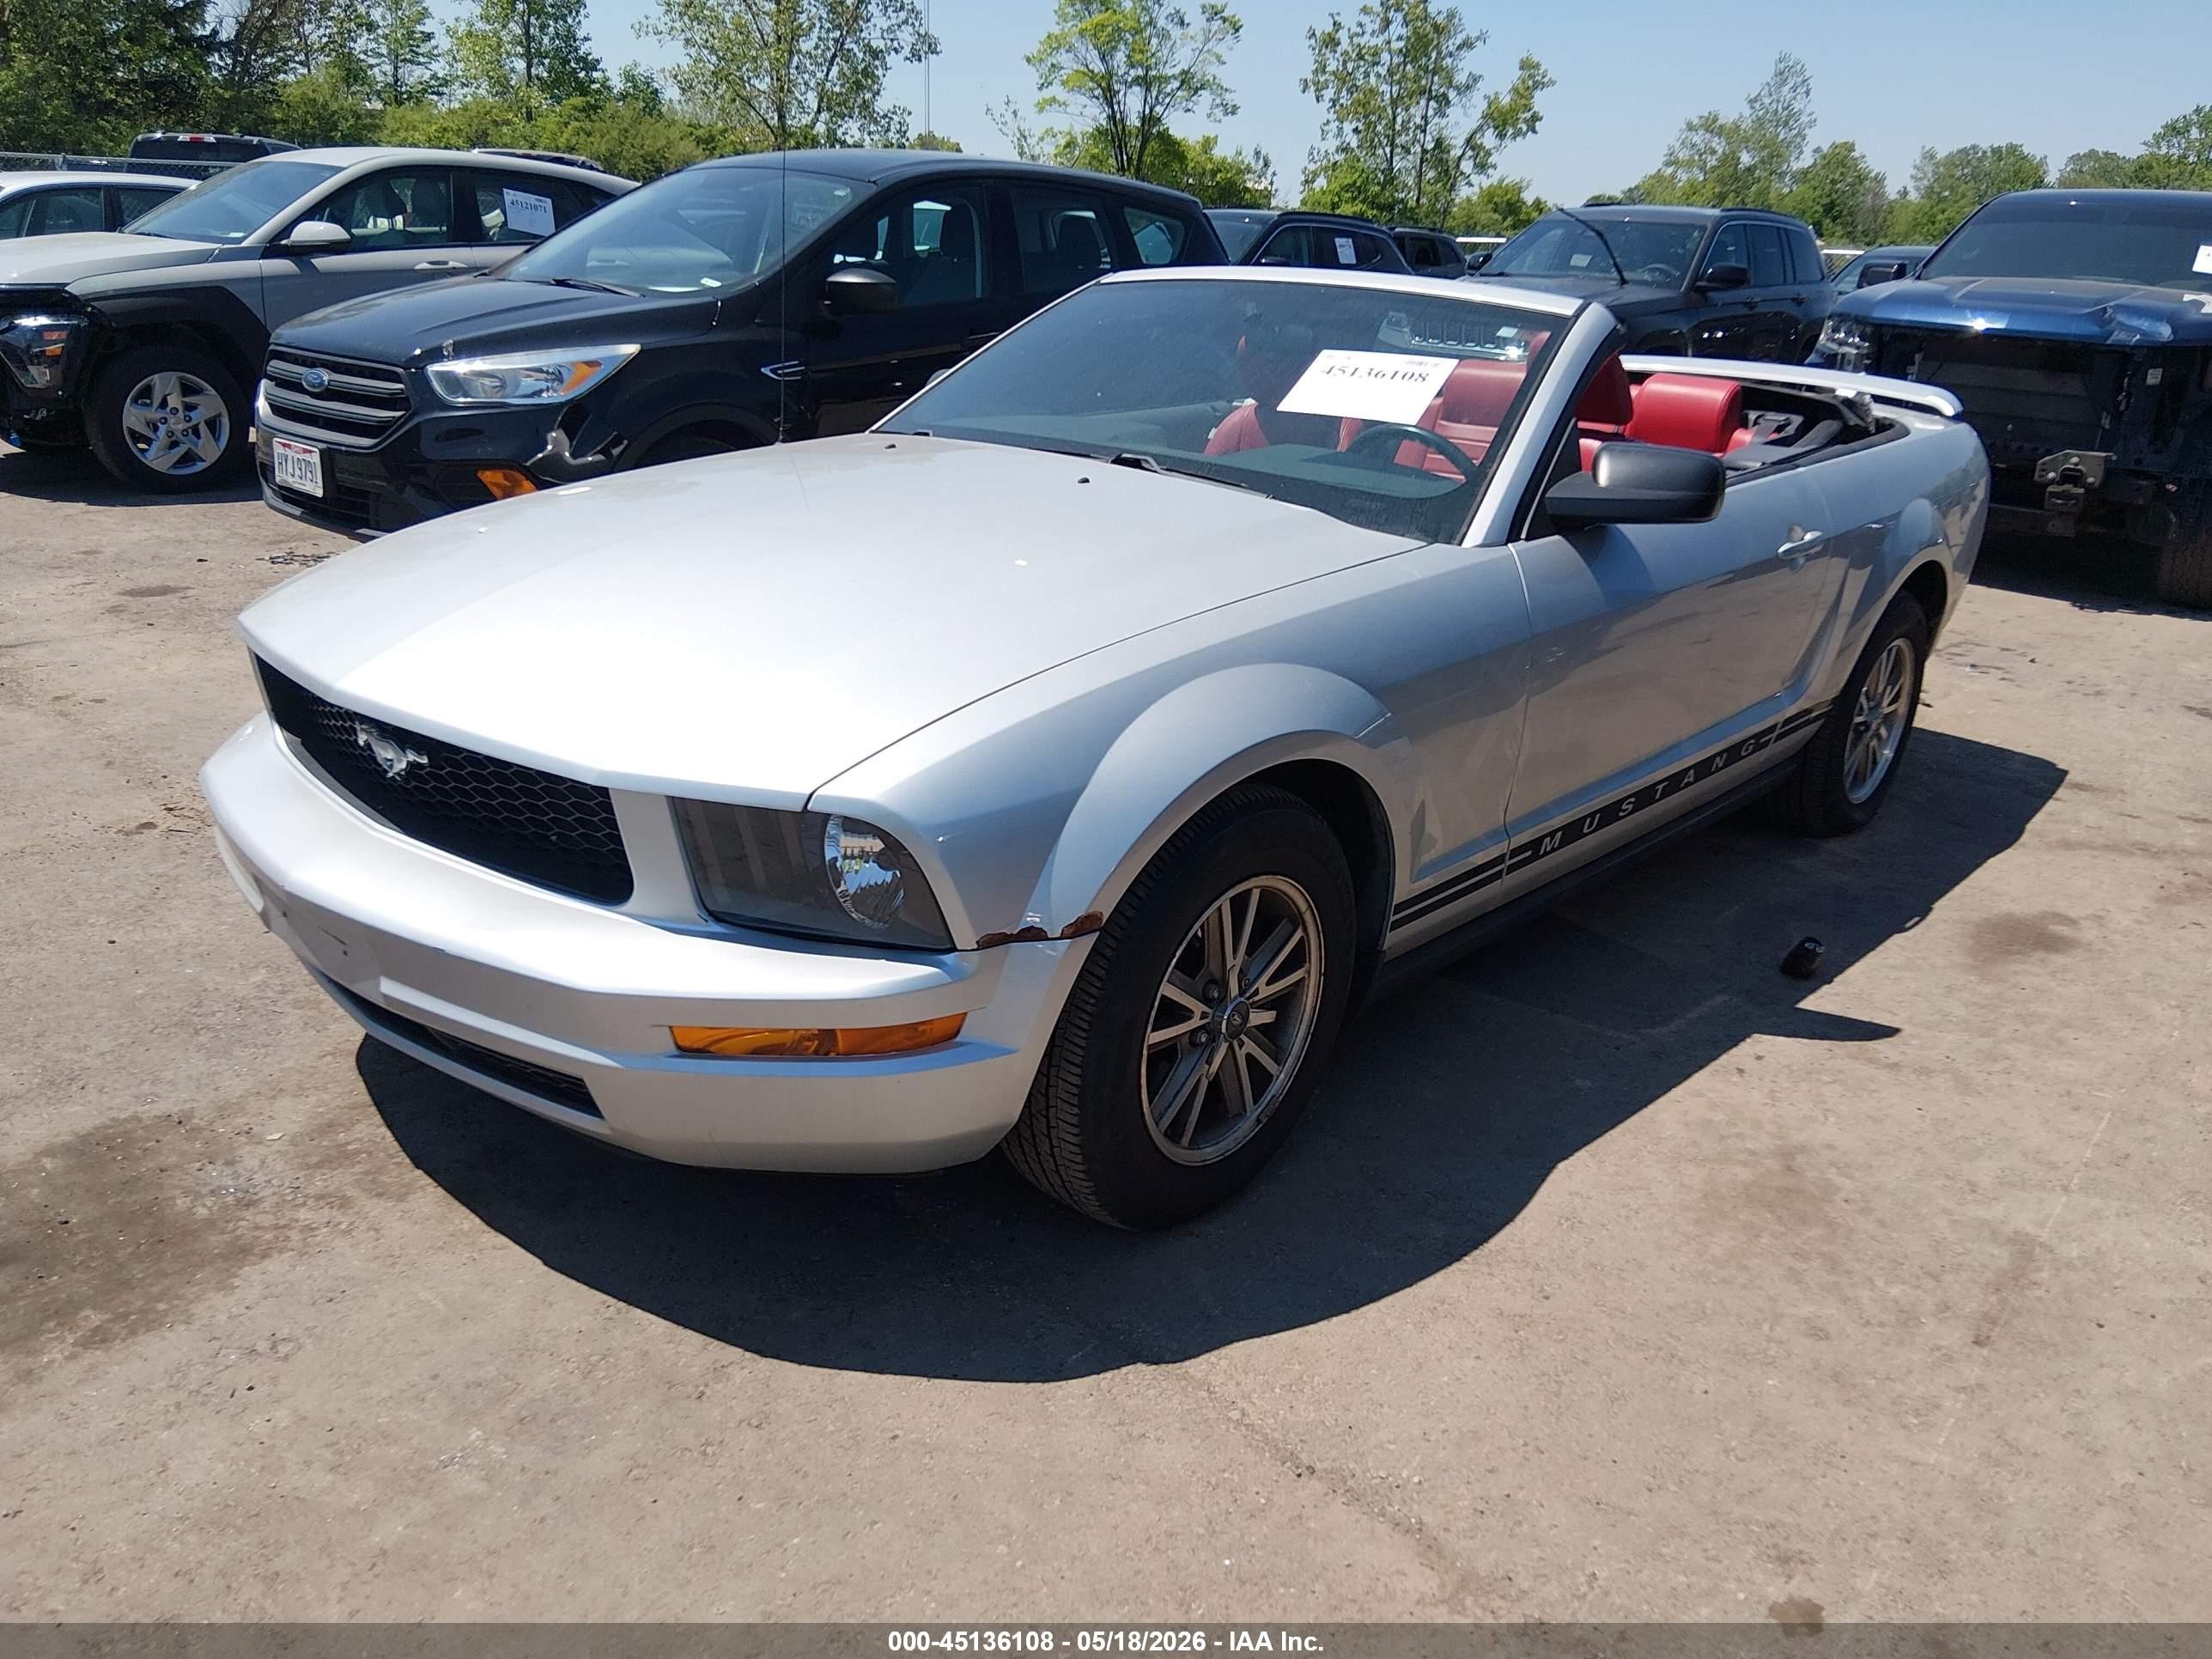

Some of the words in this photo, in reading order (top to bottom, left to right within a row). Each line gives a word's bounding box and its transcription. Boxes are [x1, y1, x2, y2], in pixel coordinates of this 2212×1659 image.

[509, 198, 547, 213] 45121071
[1322, 365, 1430, 383] 45136108
[1539, 739, 1755, 856] MUSTANG
